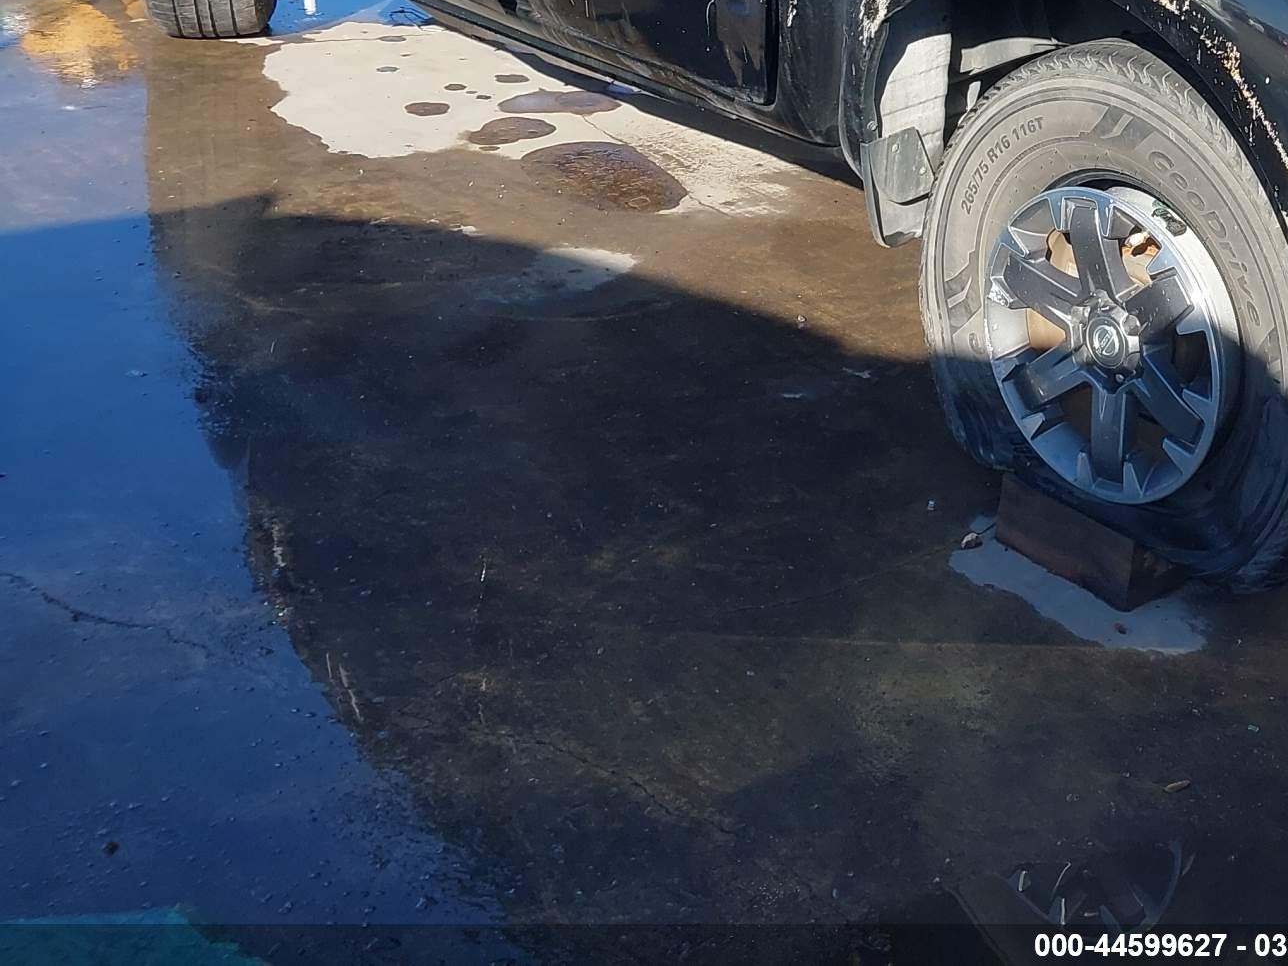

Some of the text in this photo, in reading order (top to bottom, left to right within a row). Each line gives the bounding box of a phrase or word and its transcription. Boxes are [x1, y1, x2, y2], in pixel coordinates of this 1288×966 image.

[961, 116, 1044, 214] 265/75 R16 116T
